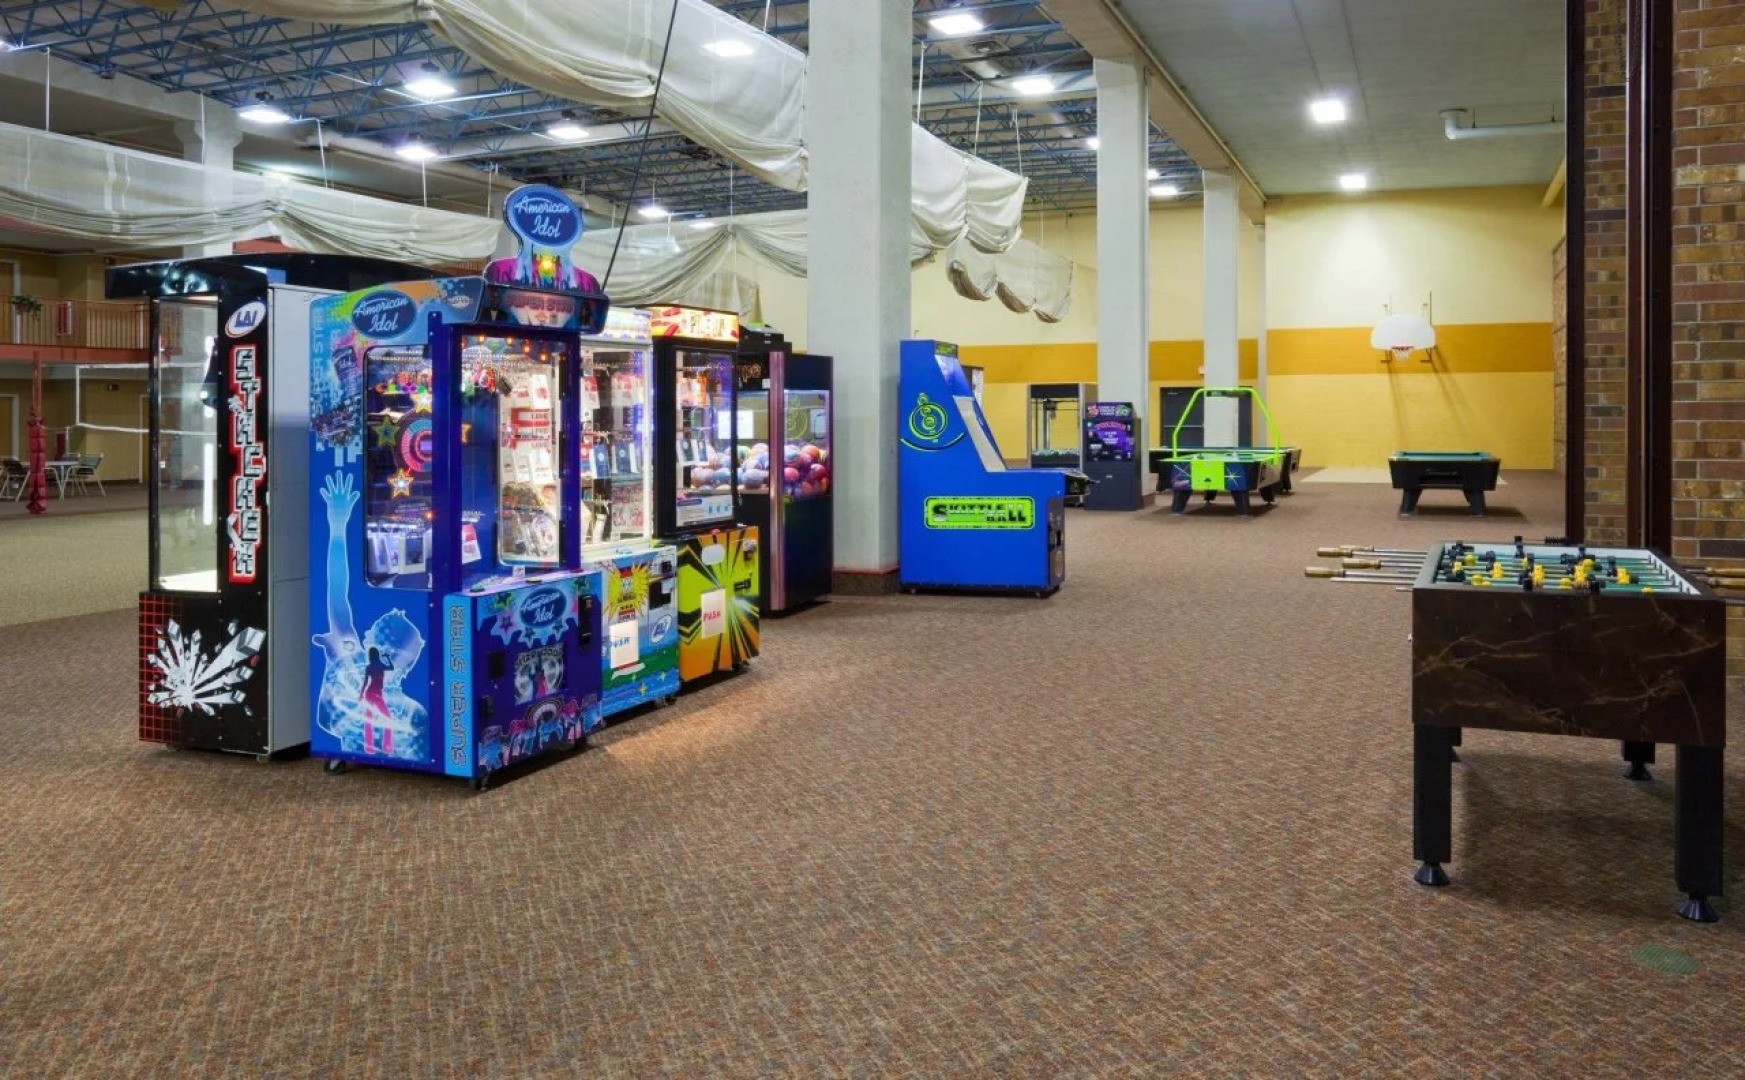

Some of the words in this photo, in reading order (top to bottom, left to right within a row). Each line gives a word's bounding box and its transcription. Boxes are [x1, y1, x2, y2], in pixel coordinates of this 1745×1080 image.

[514, 196, 570, 213] American
[532, 215, 561, 238] Idol
[353, 298, 407, 317] American
[235, 310, 257, 327] LAI
[368, 311, 399, 332] Idol
[233, 347, 264, 577] STACKER
[933, 504, 1005, 521] SKITTLE
[986, 504, 1026, 522] BALL
[520, 593, 560, 613] American
[532, 604, 554, 623] Idol
[703, 609, 722, 622] PUSH
[449, 605, 465, 673] STAR
[449, 681, 466, 767] SUPER
